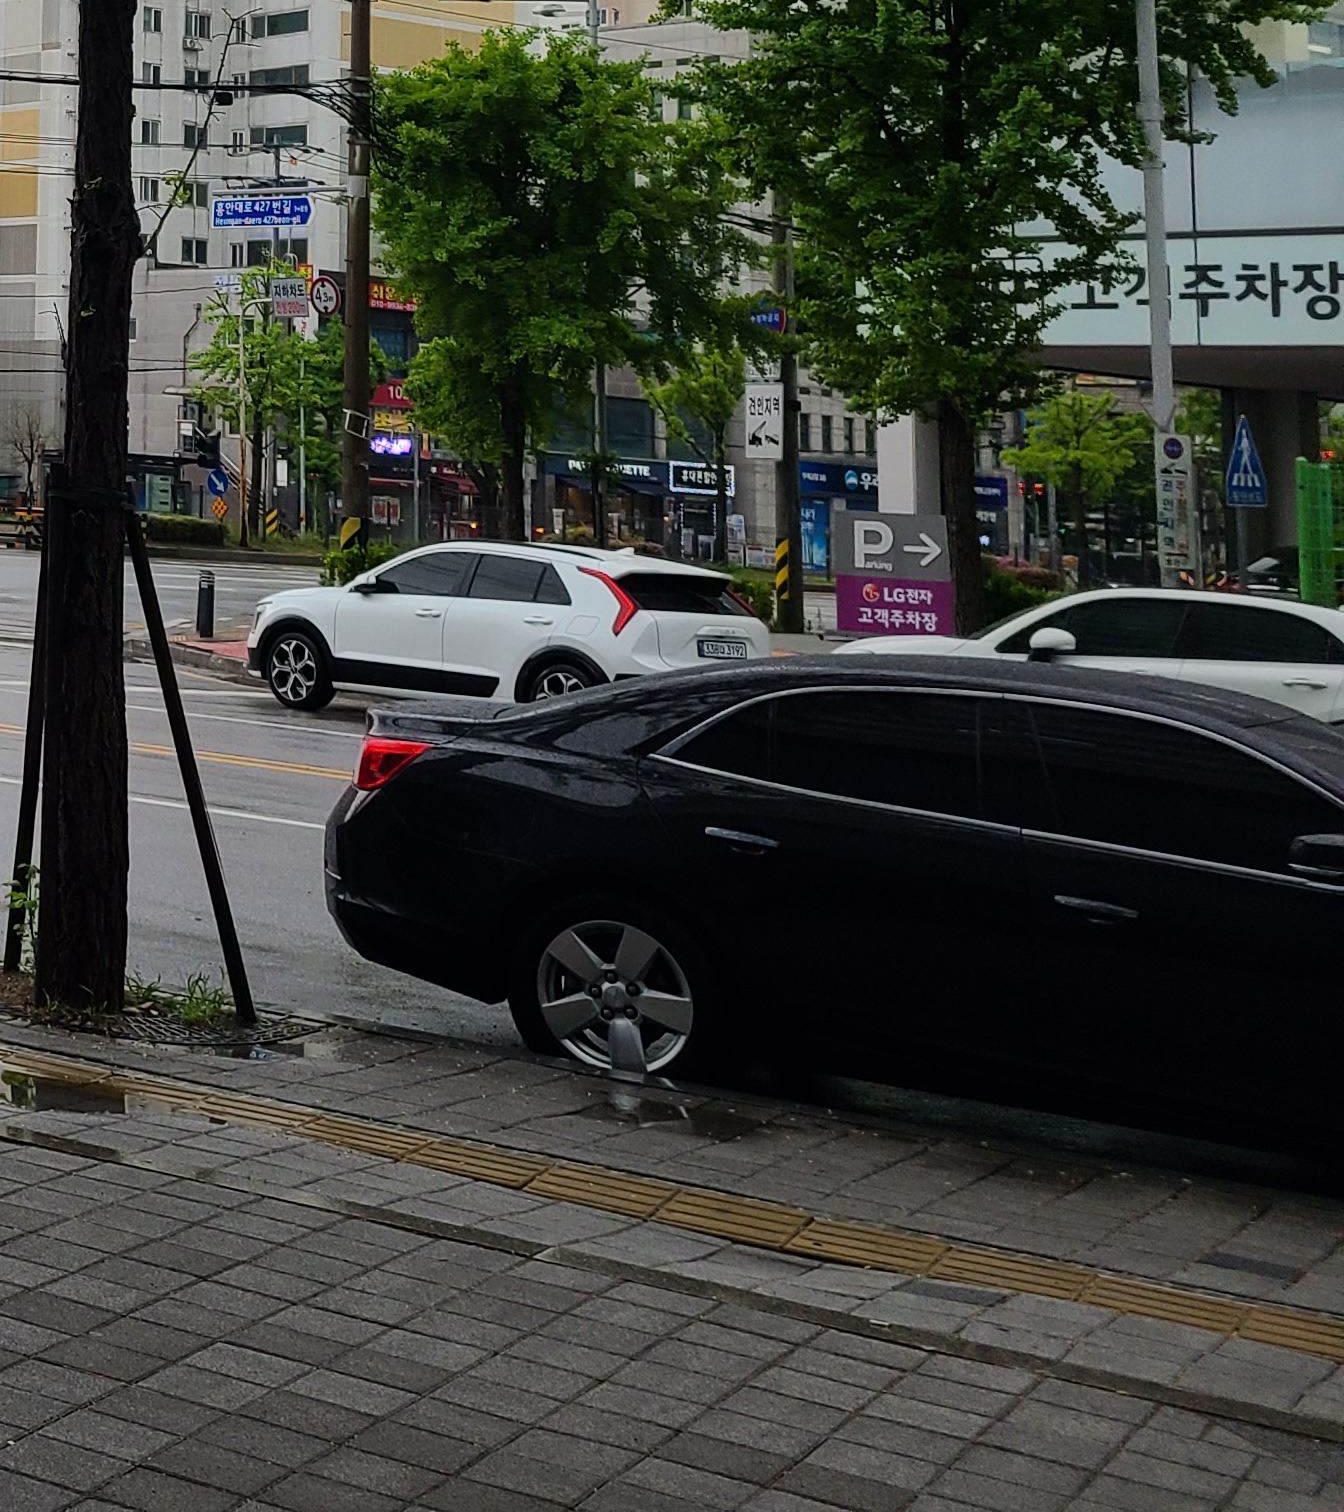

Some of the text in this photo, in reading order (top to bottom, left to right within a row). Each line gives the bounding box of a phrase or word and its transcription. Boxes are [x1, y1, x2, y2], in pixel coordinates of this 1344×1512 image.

[273, 283, 305, 298] 지하차도
[748, 395, 780, 416] 견인지역
[883, 587, 933, 605] LG전자
[858, 607, 939, 632] 고객주차장
